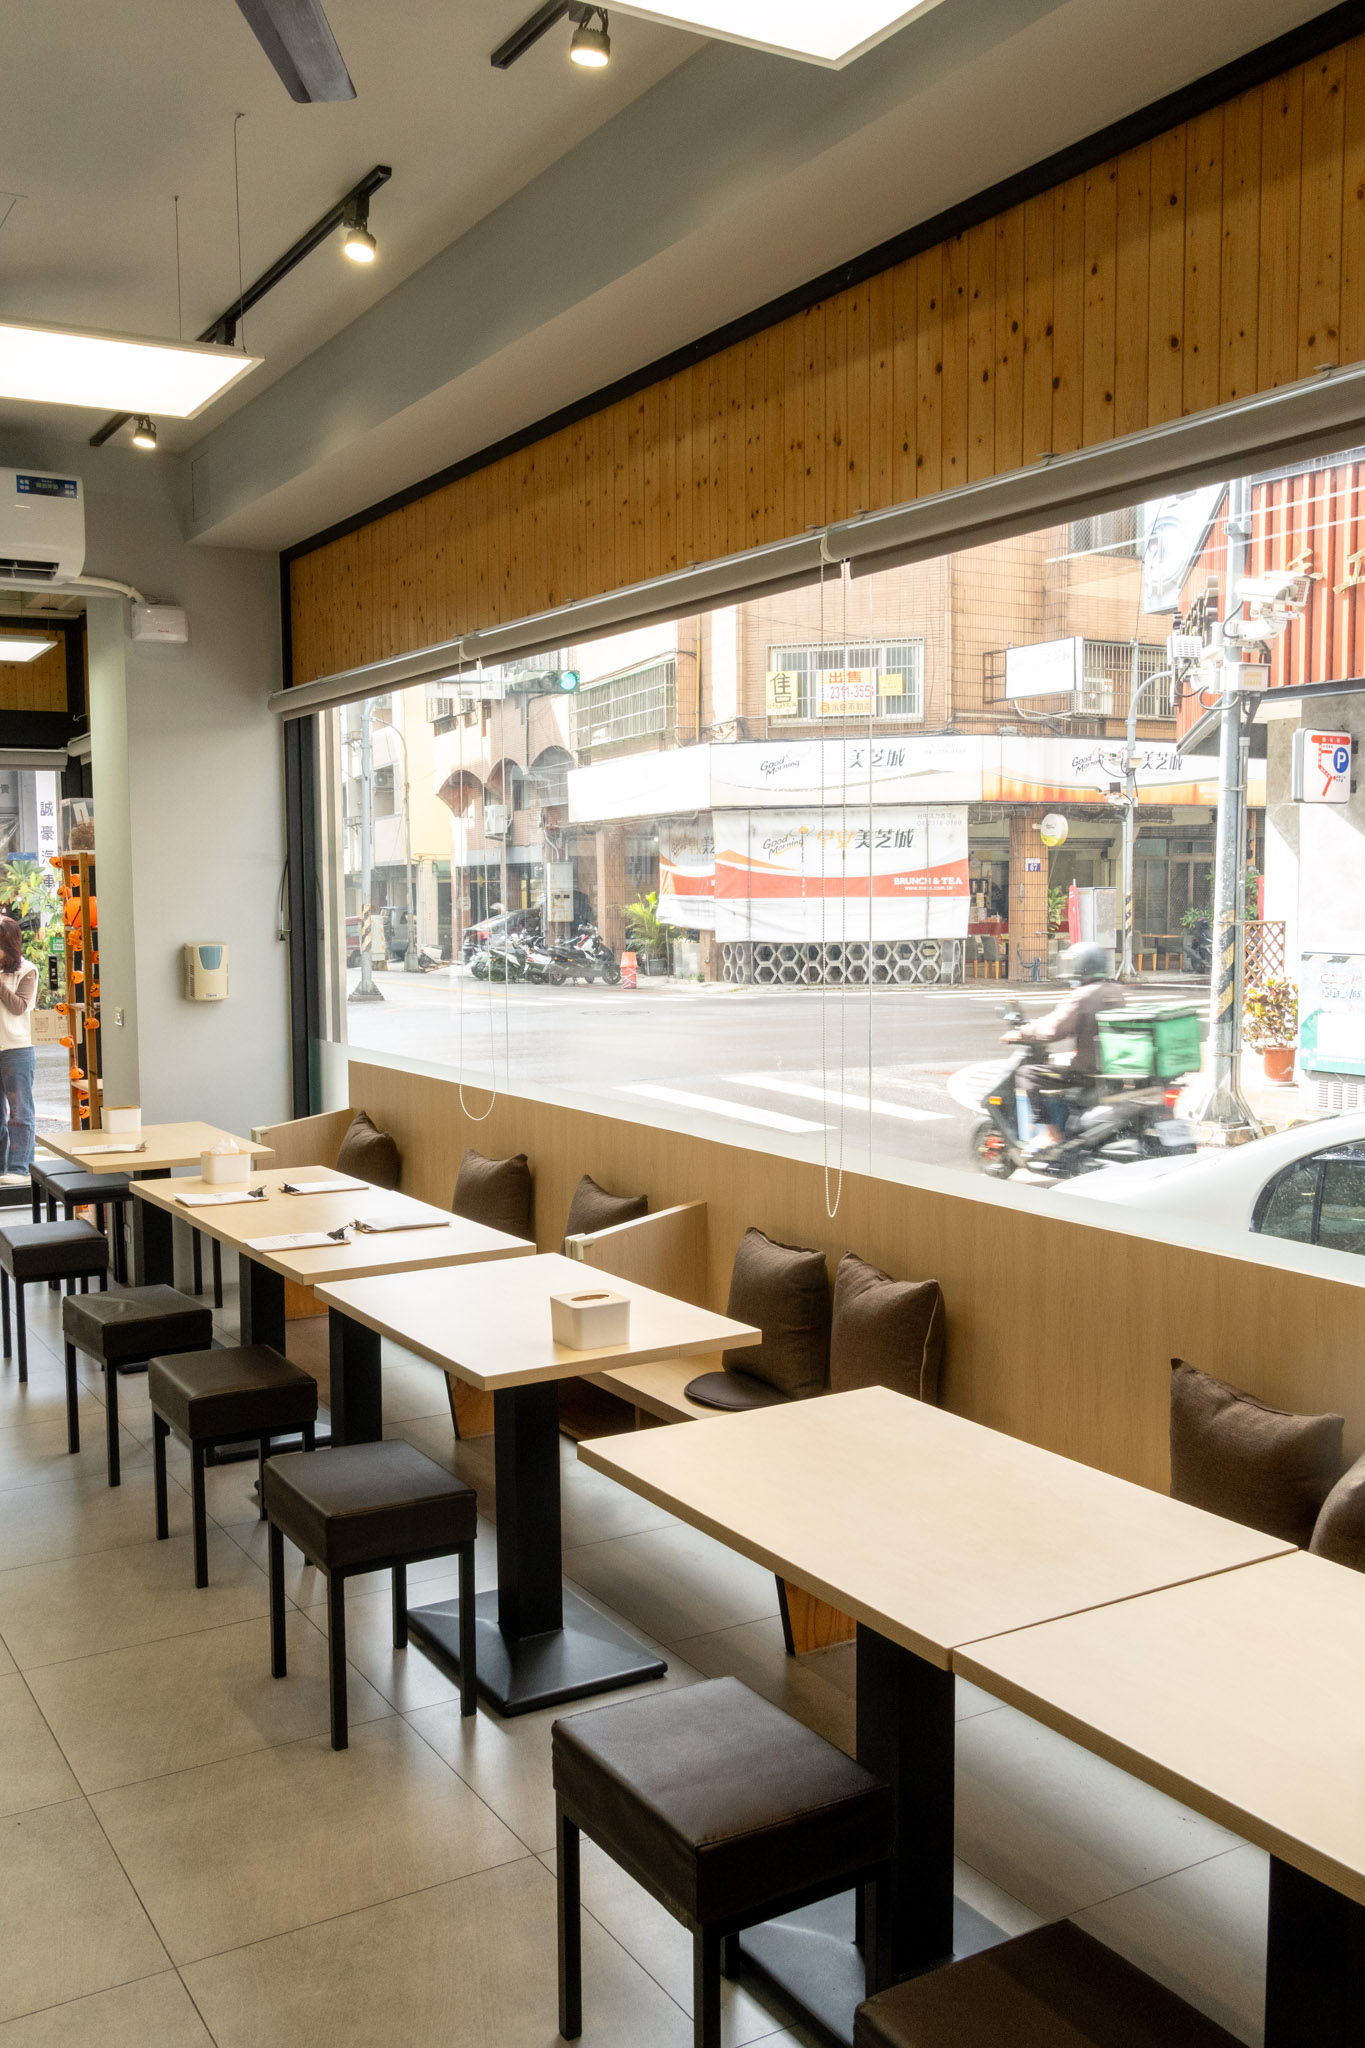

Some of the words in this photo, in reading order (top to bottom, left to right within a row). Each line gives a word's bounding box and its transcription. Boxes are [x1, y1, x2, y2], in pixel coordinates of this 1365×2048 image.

[829, 671, 862, 685] 出售
[769, 672, 792, 704] 售
[760, 755, 786, 771] Good
[1336, 751, 1347, 769] P
[765, 760, 800, 781] Morning
[762, 833, 789, 850] Good
[893, 877, 931, 885] BRUNCH
[932, 877, 940, 885] &
[941, 876, 963, 885] TEA
